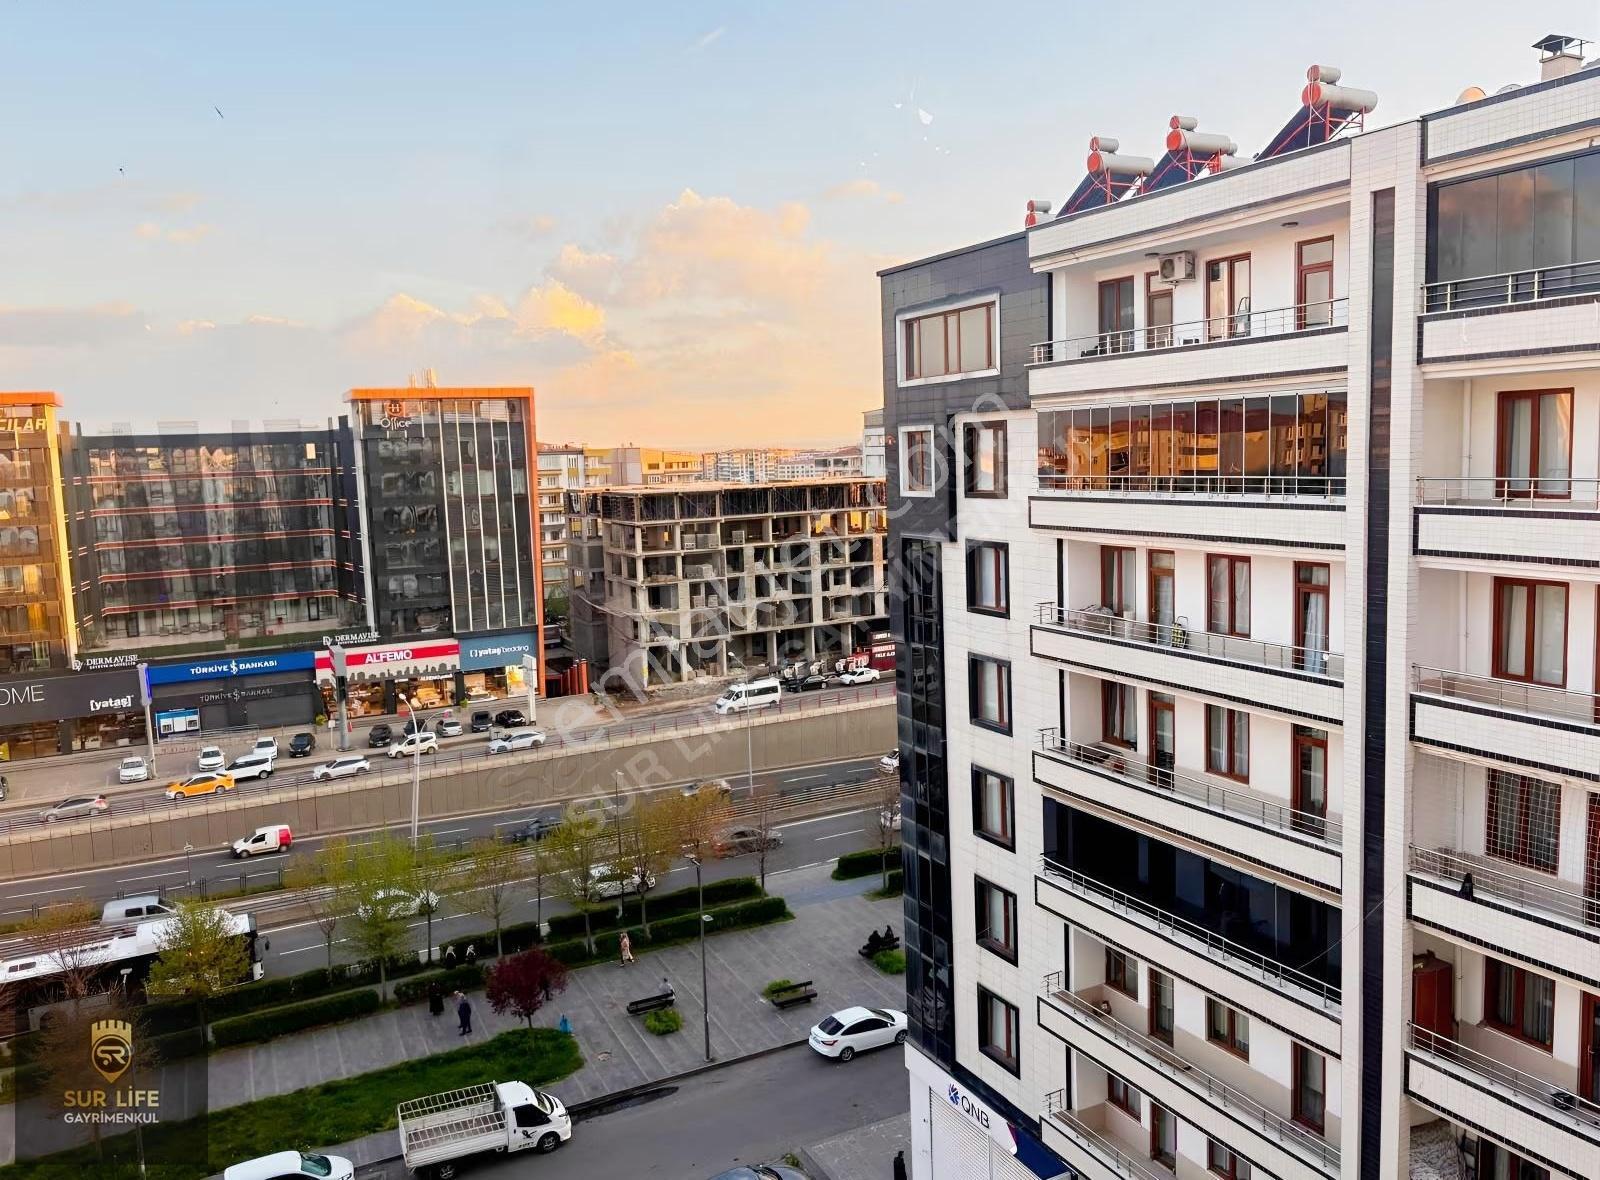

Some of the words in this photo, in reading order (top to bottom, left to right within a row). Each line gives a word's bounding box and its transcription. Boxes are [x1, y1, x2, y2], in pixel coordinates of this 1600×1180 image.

[380, 417, 411, 431] Office
[190, 664, 229, 675] TÜRKİYE
[239, 660, 277, 670] BANKASI
[961, 1095, 990, 1129] QNB
